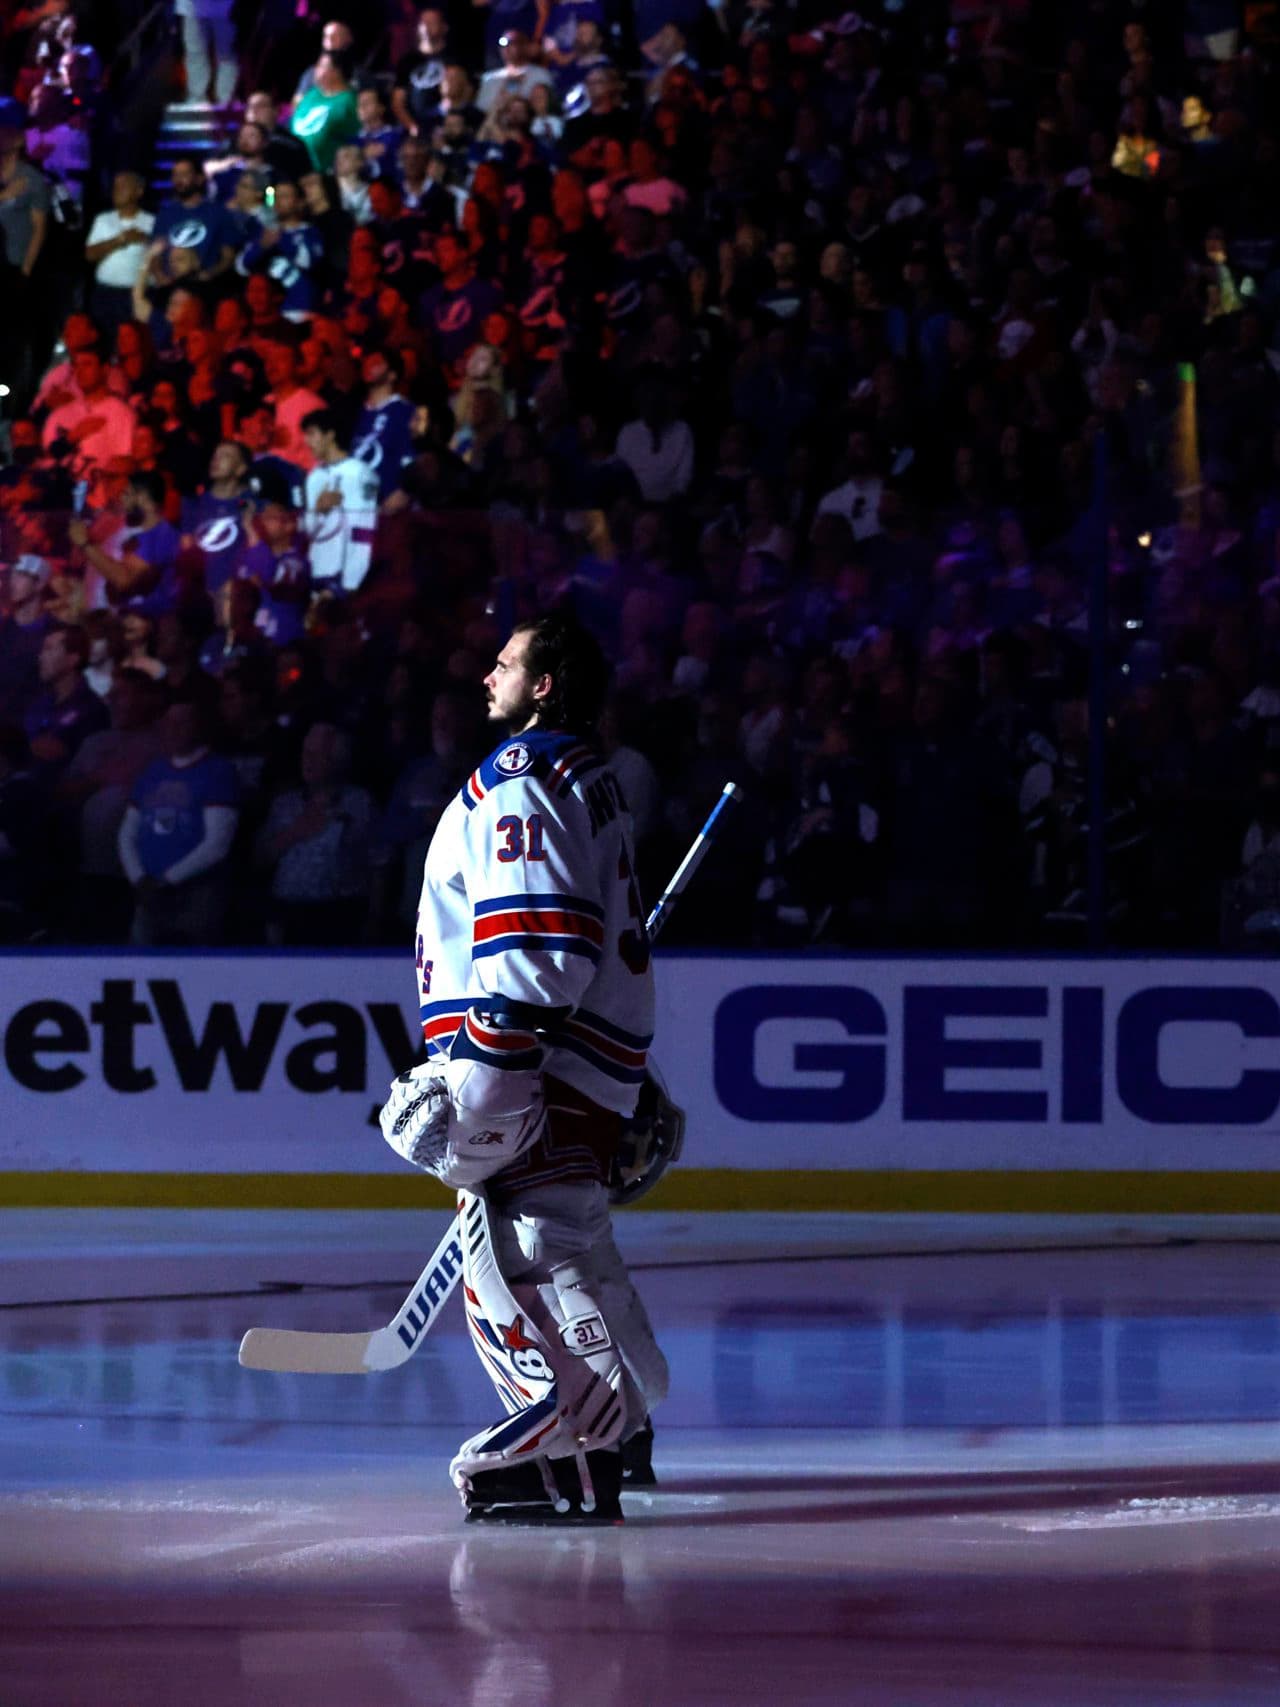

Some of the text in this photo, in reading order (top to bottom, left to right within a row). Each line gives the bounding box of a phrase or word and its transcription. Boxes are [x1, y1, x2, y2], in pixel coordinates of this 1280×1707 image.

[496, 813, 546, 863] 31
[416, 912, 434, 994] RS
[398, 1229, 464, 1349] WAR
[574, 1324, 598, 1344] 31
